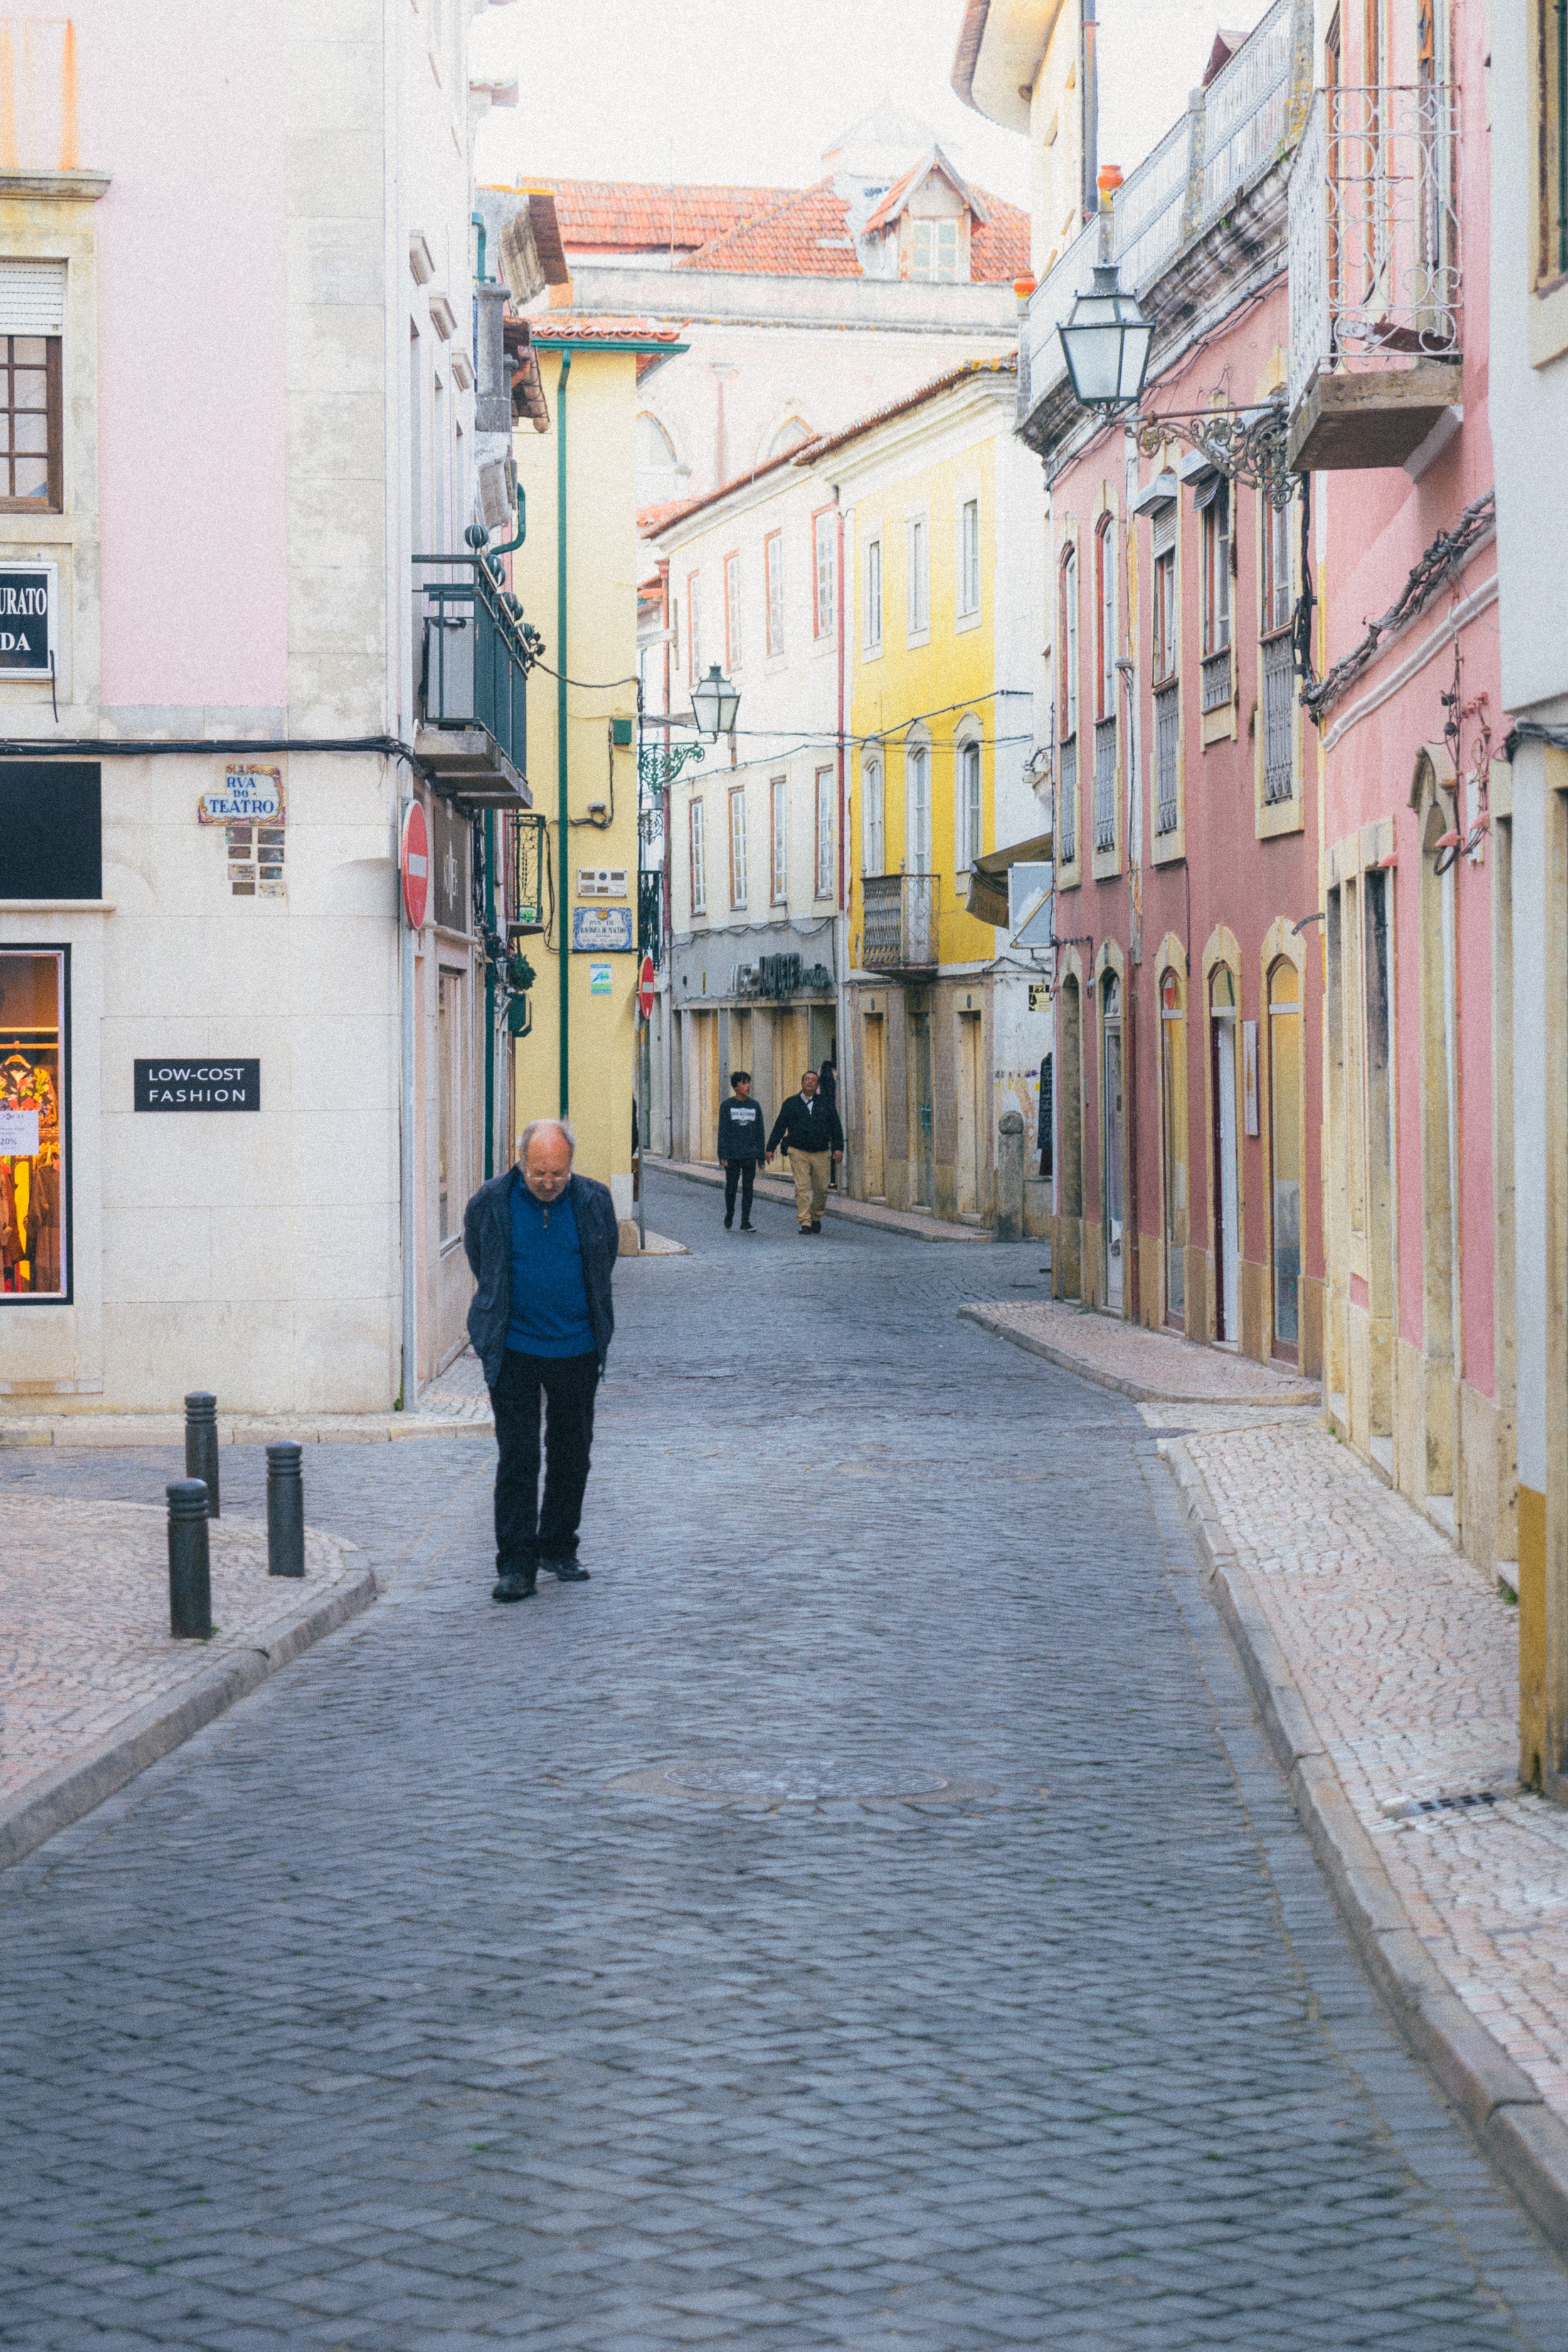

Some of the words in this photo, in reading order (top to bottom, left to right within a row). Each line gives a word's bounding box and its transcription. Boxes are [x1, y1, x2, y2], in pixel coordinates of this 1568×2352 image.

[227, 776, 256, 788] RVA
[233, 790, 249, 798] DO
[209, 799, 275, 813] TEATRO
[149, 1068, 245, 1081] LOW-COST
[149, 1089, 246, 1102] FASHION
